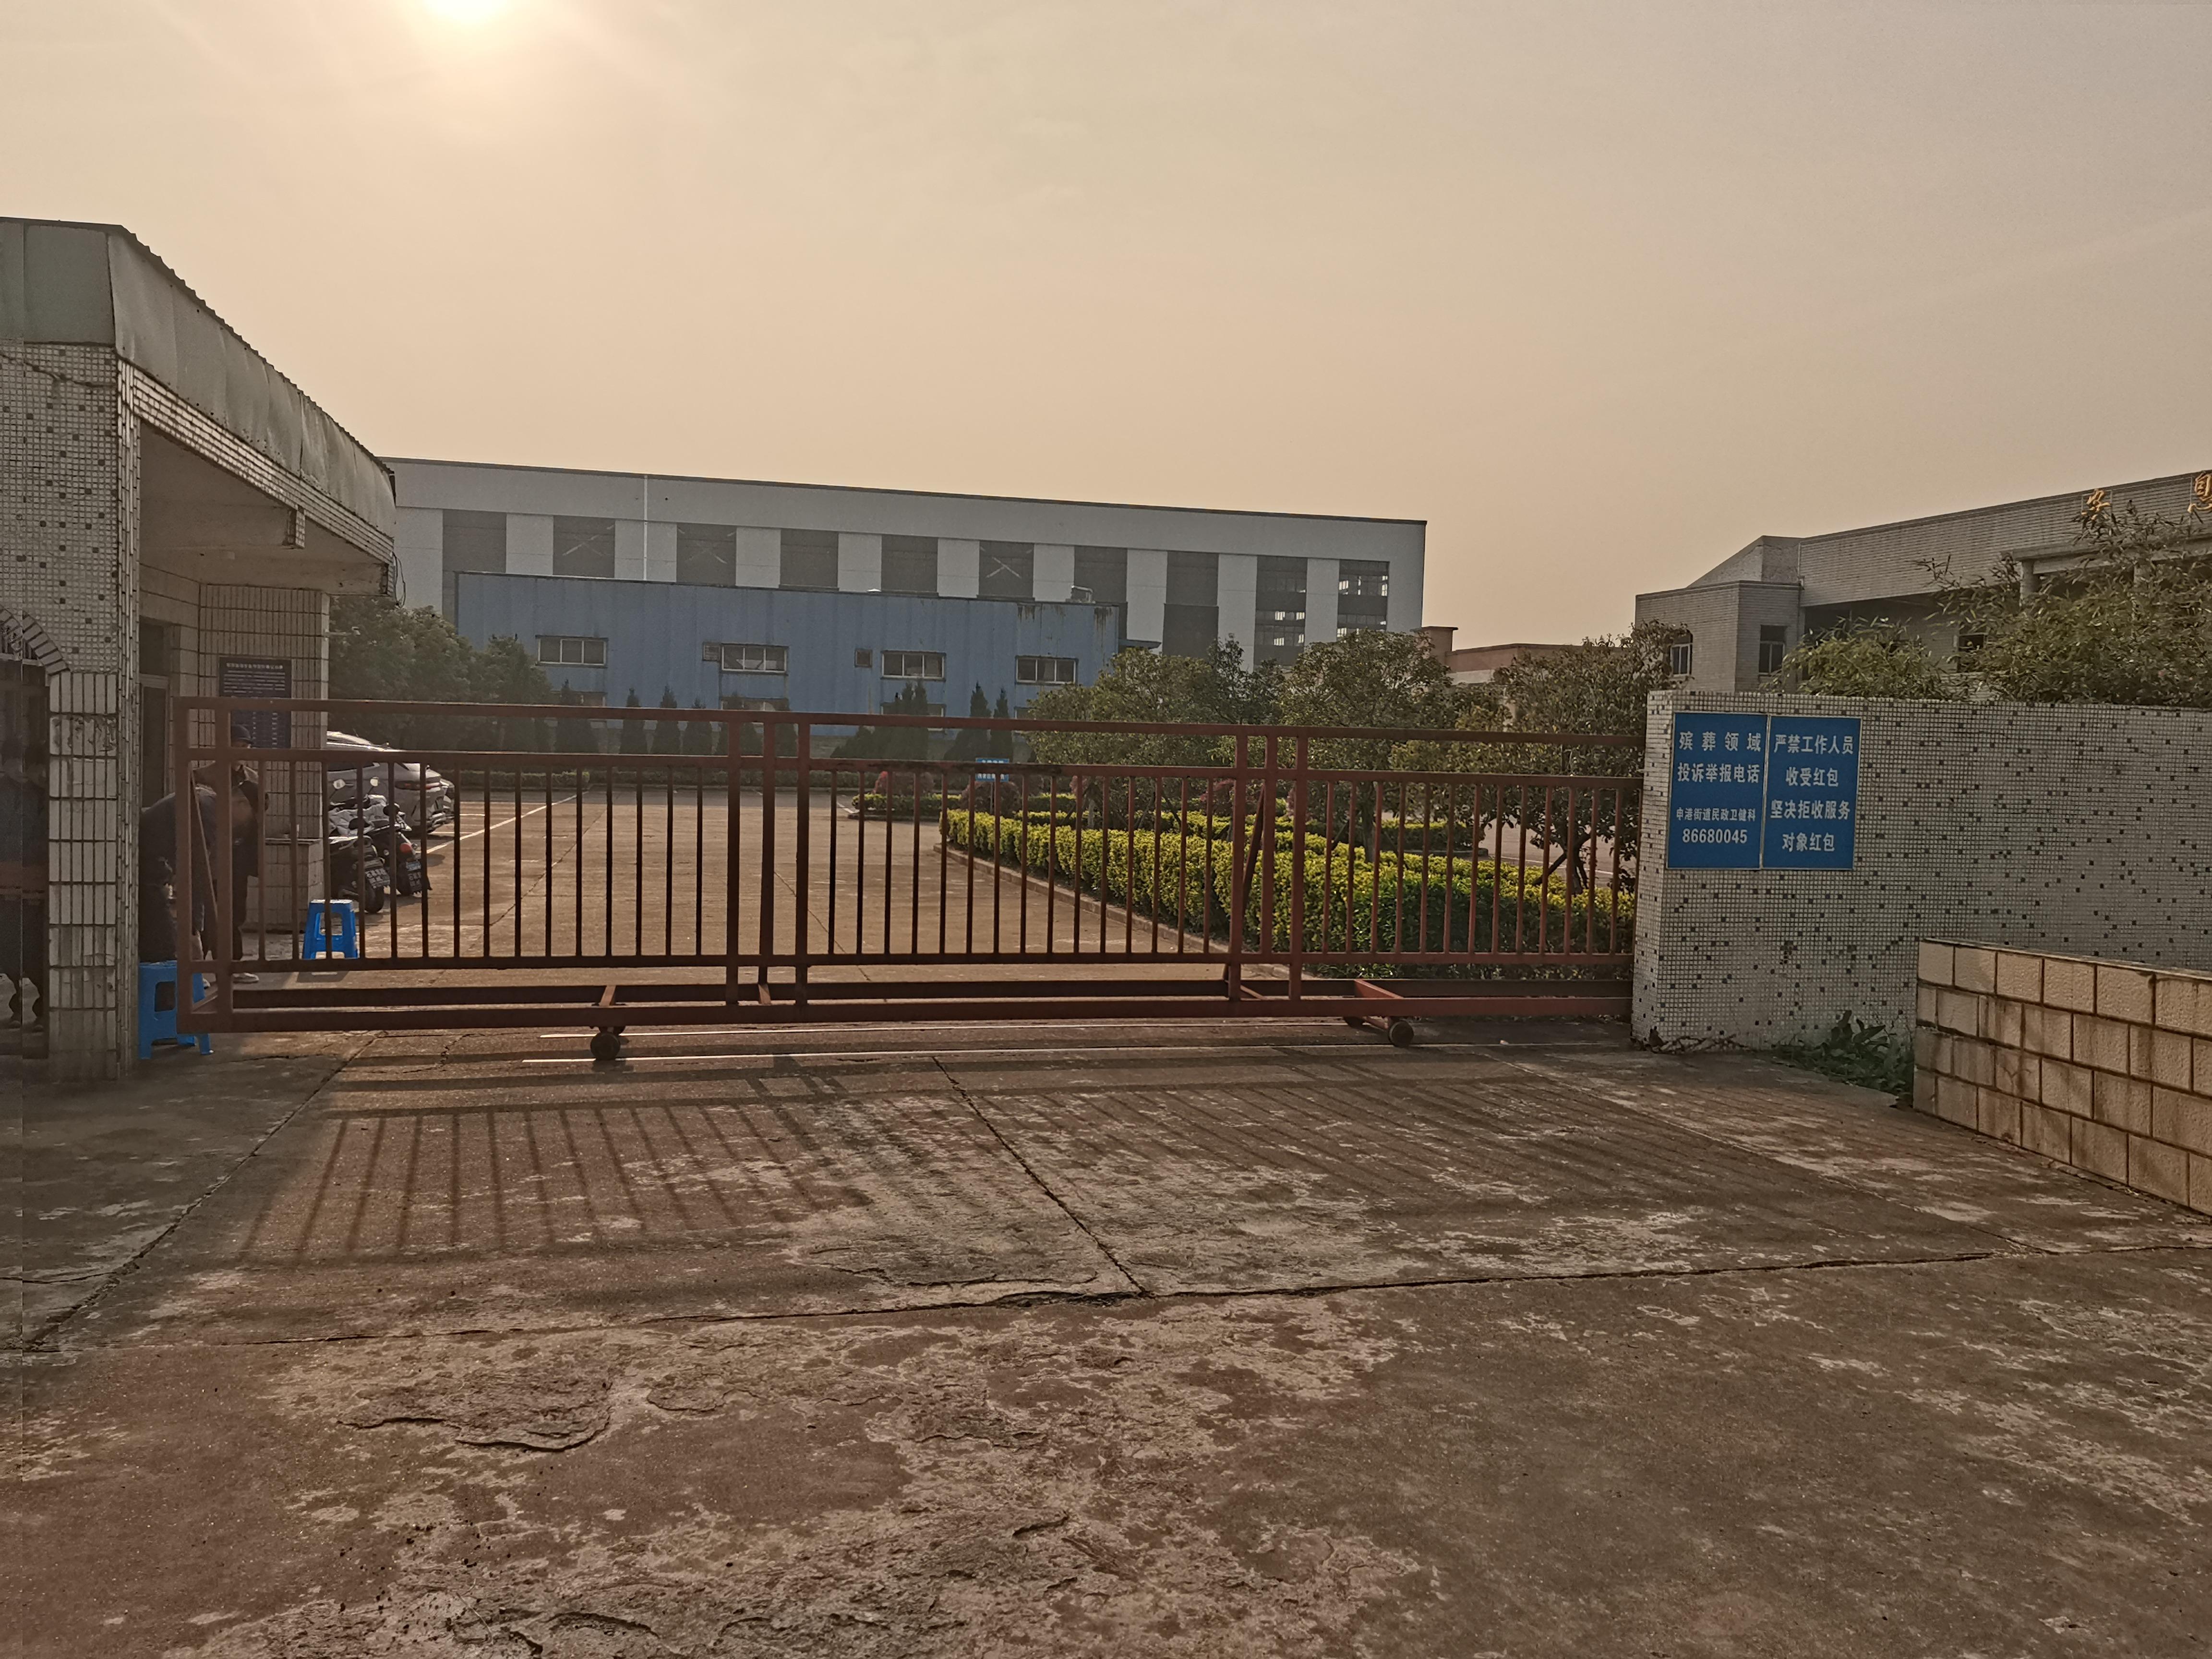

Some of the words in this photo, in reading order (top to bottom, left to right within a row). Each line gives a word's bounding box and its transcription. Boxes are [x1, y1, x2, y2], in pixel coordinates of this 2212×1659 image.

[1774, 734, 1853, 755] 严禁工作人员
[1677, 762, 1760, 783] 投诉举报电话
[1785, 767, 1839, 787] 收受红包
[1676, 807, 1755, 822] 申港街道民政卫健科
[1770, 799, 1850, 820] 坚决拒收服务
[1682, 828, 1747, 843] 86680045
[1782, 832, 1835, 852] 对象红包
